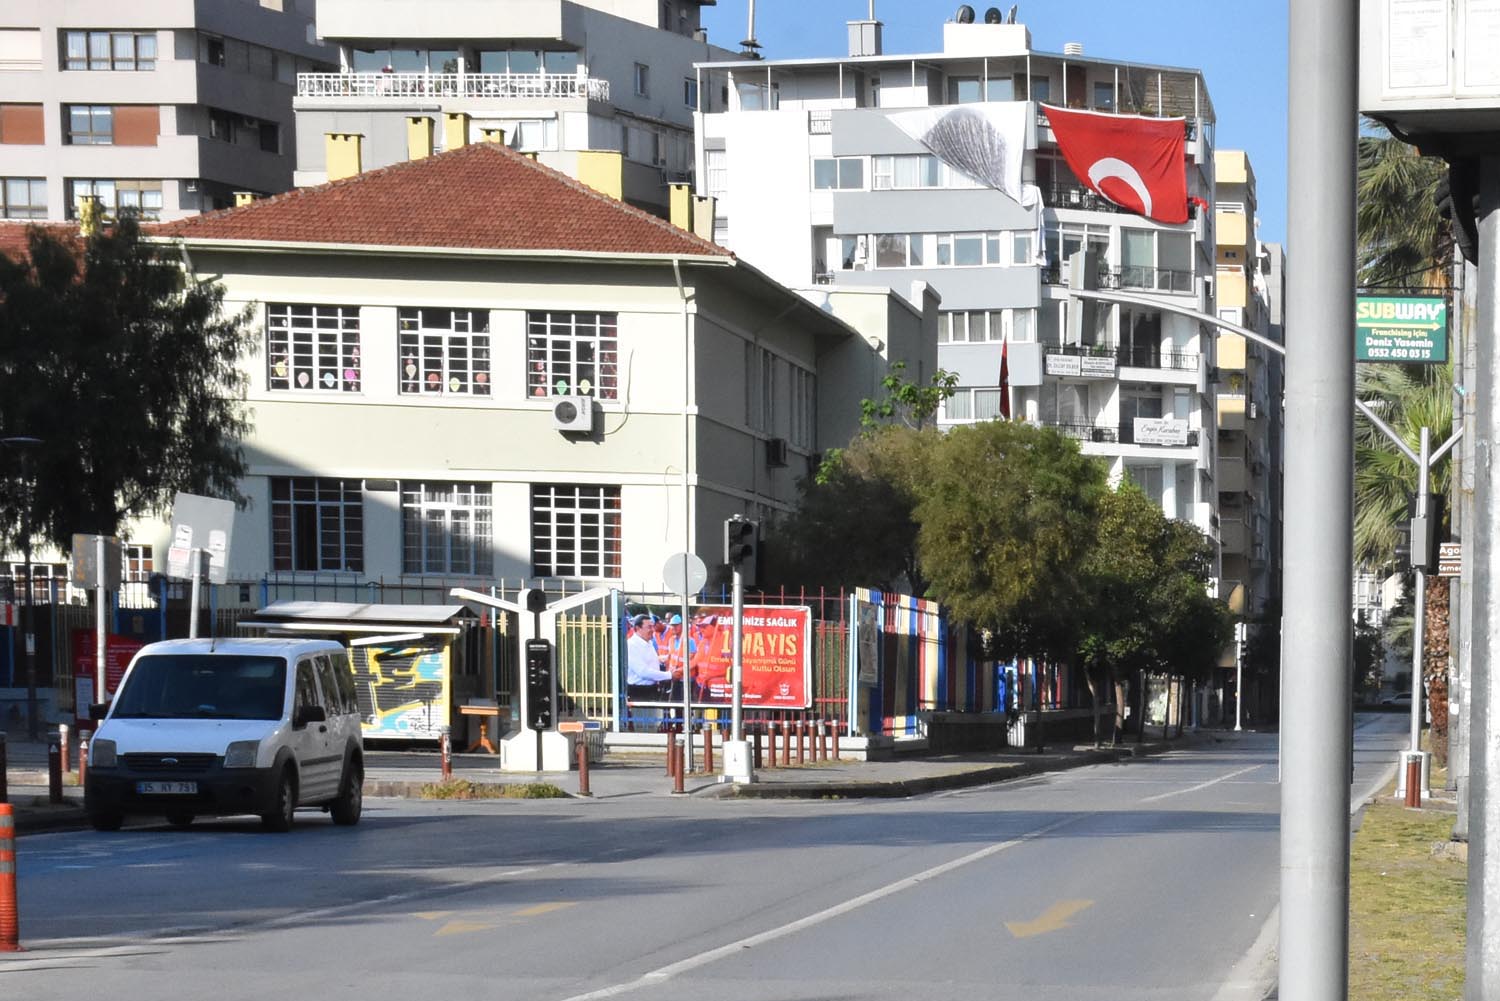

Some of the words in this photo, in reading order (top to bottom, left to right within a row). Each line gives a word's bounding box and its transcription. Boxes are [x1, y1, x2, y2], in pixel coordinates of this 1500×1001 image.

[1357, 302, 1444, 320] SUBWAY
[1372, 329, 1412, 338] Franchising
[1366, 337, 1393, 347] Deniz
[1394, 338, 1433, 348] Yasemin
[1391, 348, 1408, 358] 450
[1422, 349, 1431, 358] 15
[766, 617, 797, 627] SAĞLIK
[742, 632, 797, 656] MAYIS
